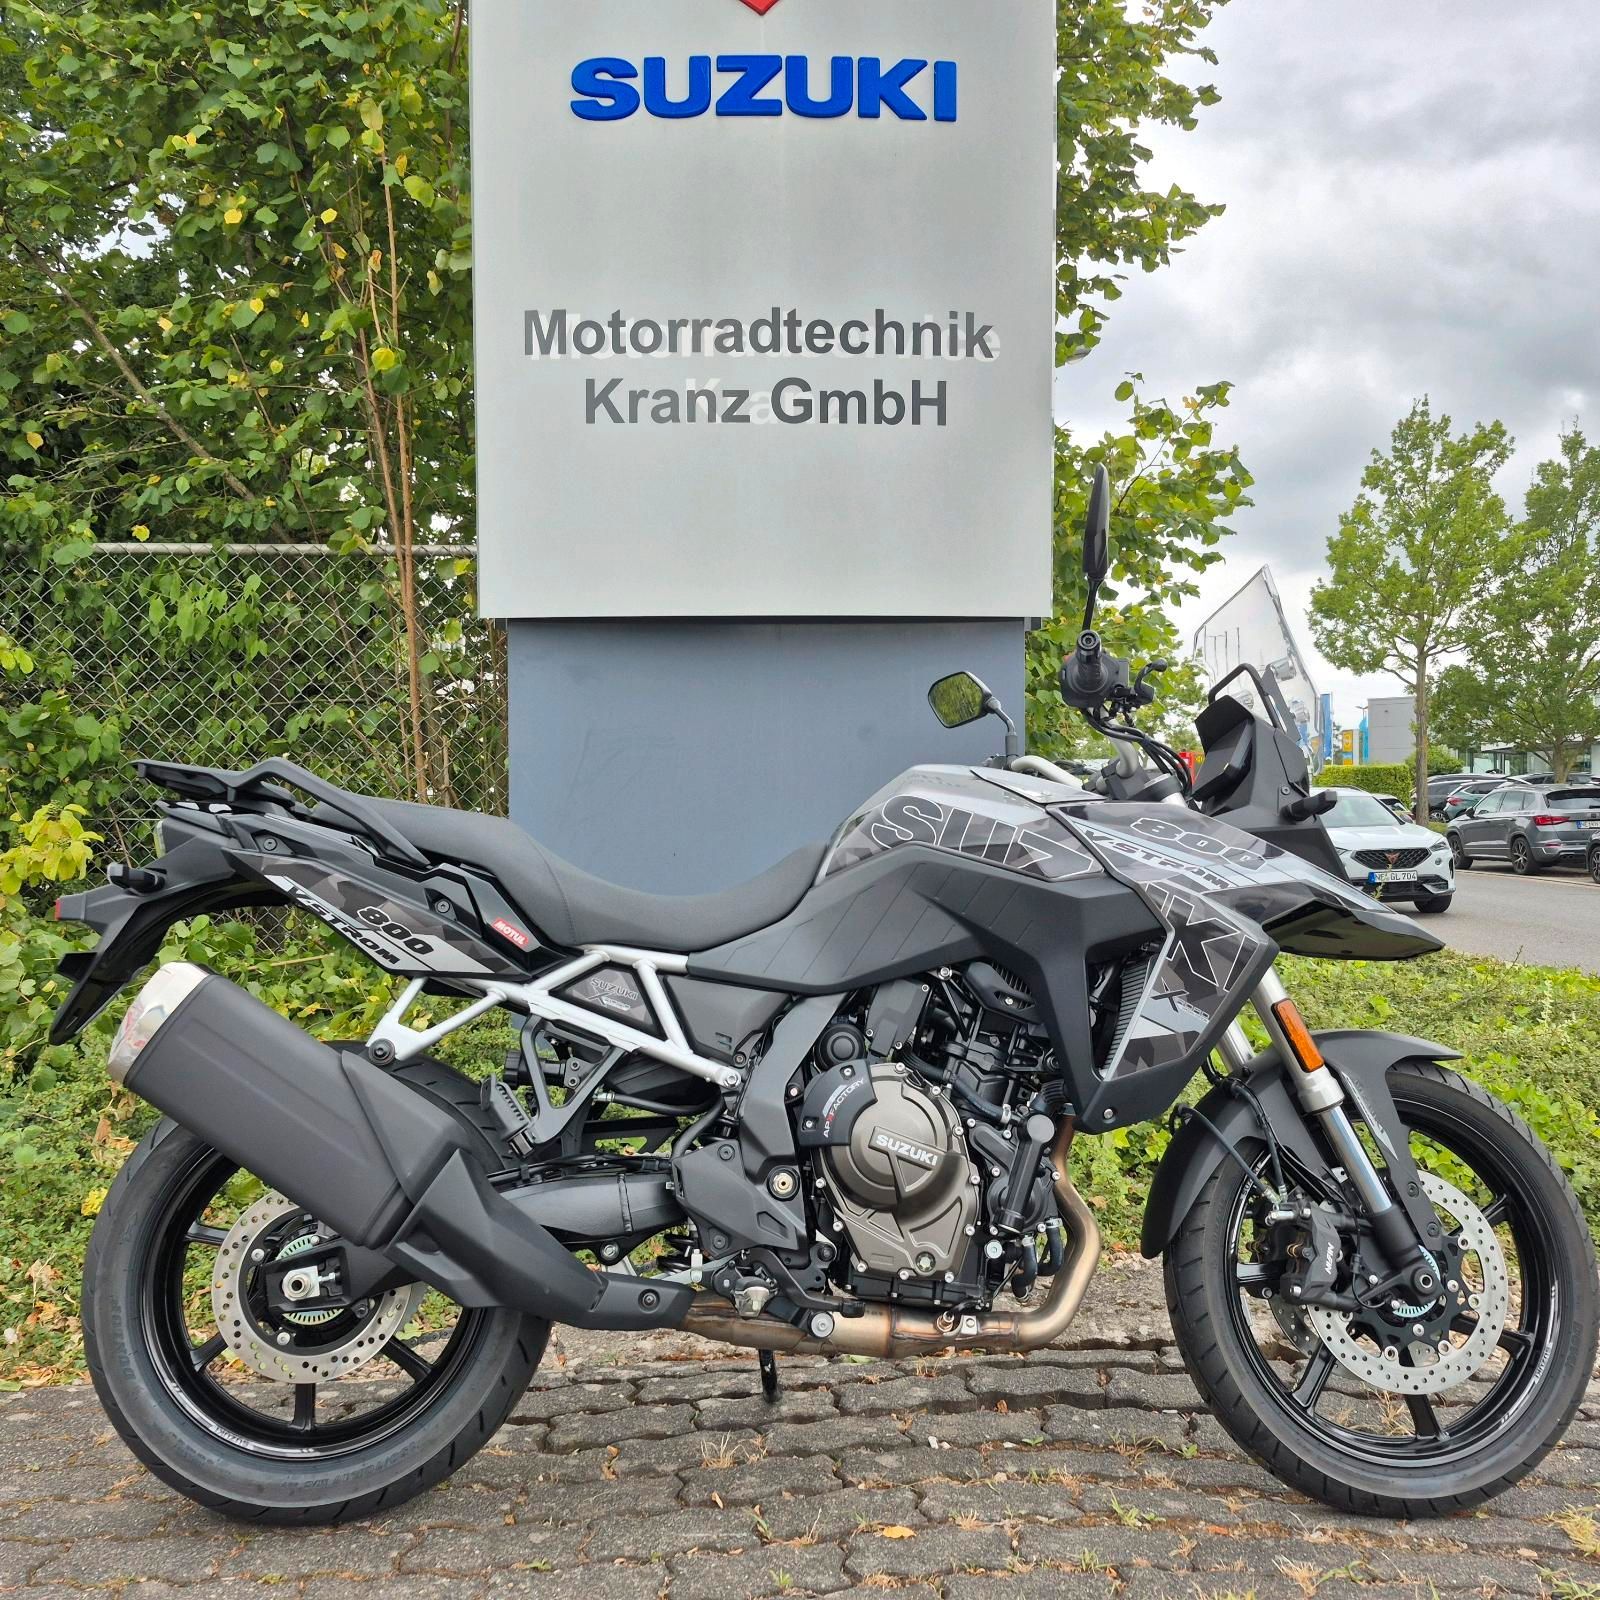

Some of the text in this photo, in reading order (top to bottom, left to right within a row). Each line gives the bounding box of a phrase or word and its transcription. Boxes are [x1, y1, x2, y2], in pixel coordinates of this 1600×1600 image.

[570, 55, 957, 122] SUZUKI
[523, 307, 994, 358] Motorradtechnik
[584, 378, 751, 425] Kranz
[770, 377, 947, 426] GmbH
[1130, 817, 1267, 872] 800
[357, 906, 434, 955] 800
[493, 920, 526, 945] MOTUL
[590, 978, 638, 1000] SUZUKI
[876, 1134, 938, 1166] SUZUKI
